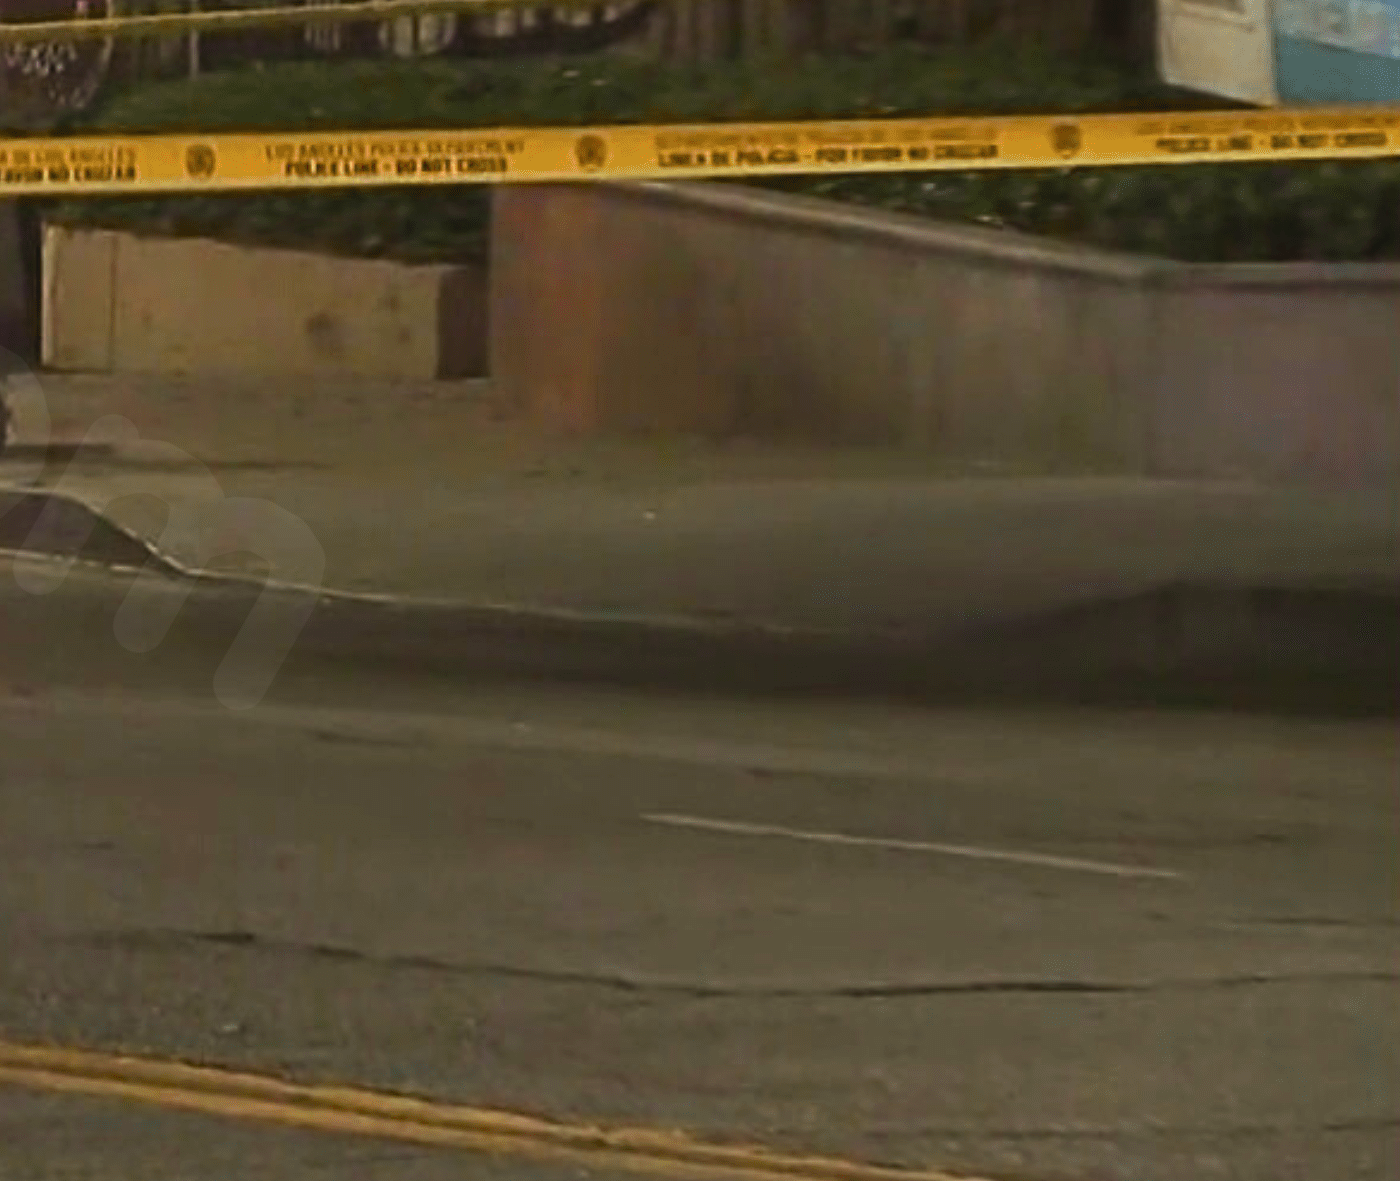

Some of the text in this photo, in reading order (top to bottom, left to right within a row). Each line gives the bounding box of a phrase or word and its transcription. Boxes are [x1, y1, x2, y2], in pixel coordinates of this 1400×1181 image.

[286, 161, 337, 176] POLICE
[343, 160, 377, 175] LINE
[422, 159, 451, 173] NOT
[458, 158, 507, 172] CROSS
